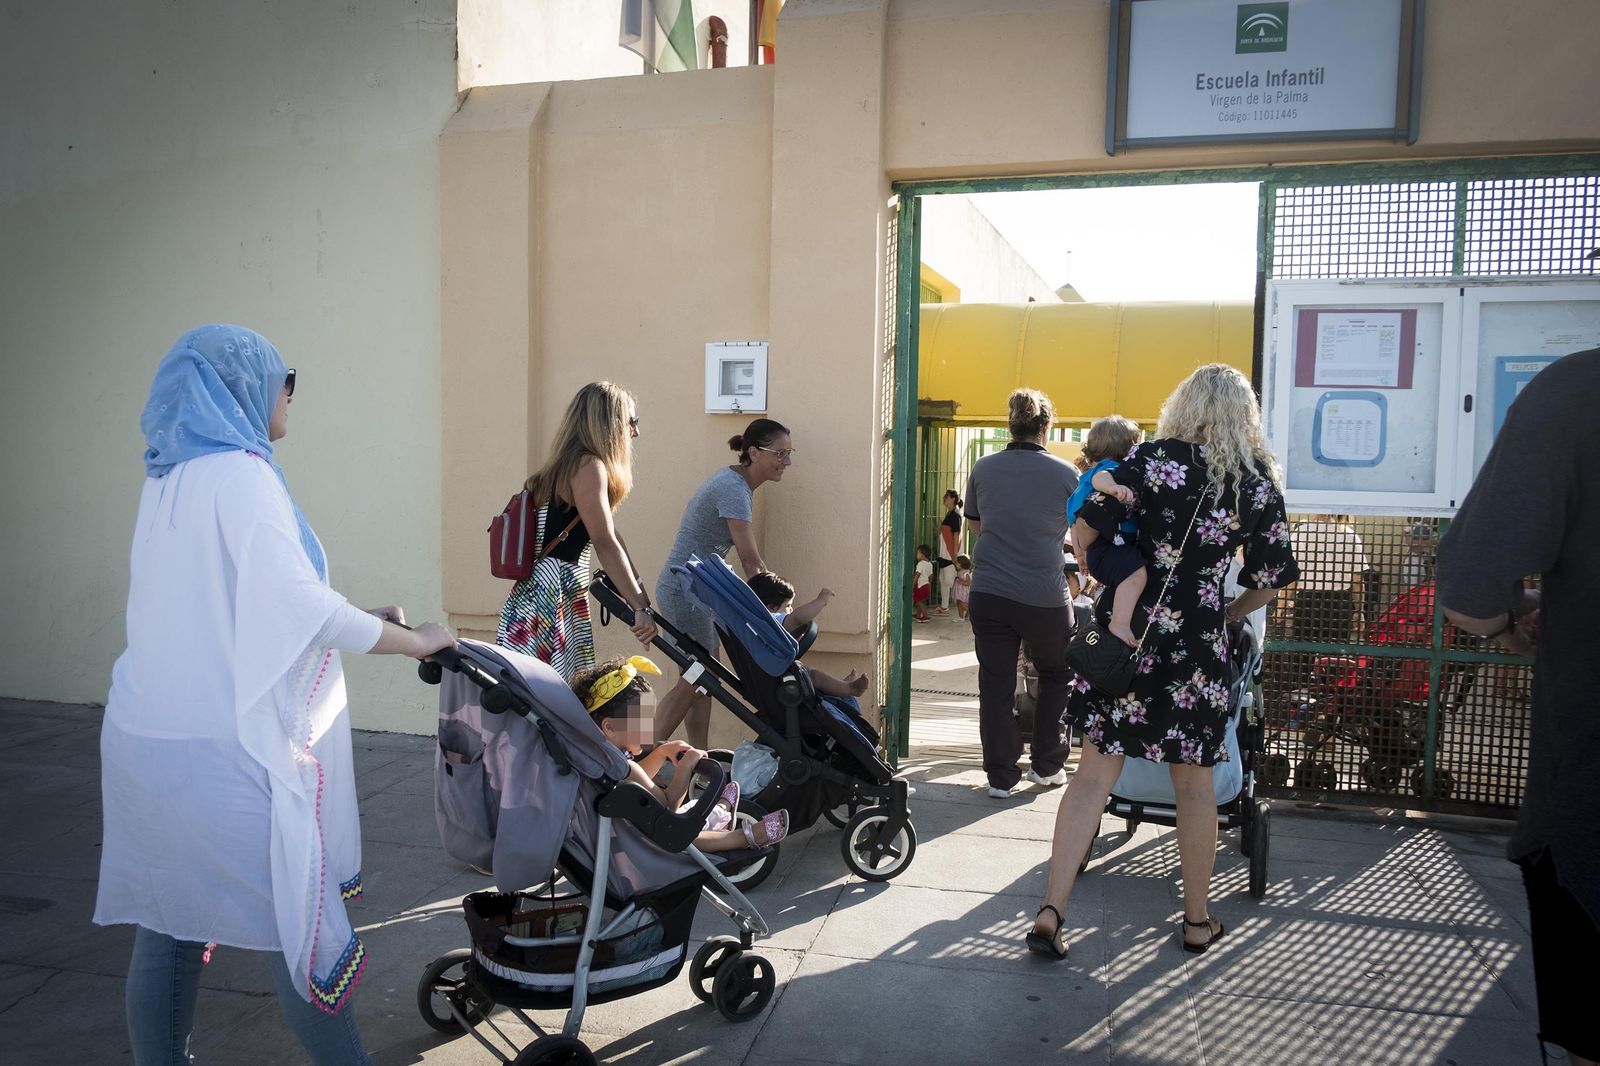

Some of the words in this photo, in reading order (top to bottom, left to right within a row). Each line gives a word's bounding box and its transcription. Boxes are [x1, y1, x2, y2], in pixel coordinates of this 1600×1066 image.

[1195, 71, 1259, 91] Escuela
[1265, 67, 1325, 87] Infantil
[1210, 93, 1242, 108] Virgen
[1246, 92, 1259, 105] de
[1263, 92, 1272, 105] la
[1276, 90, 1308, 104] Palma
[1218, 111, 1250, 124] Código:
[1254, 109, 1298, 121] 11011445
